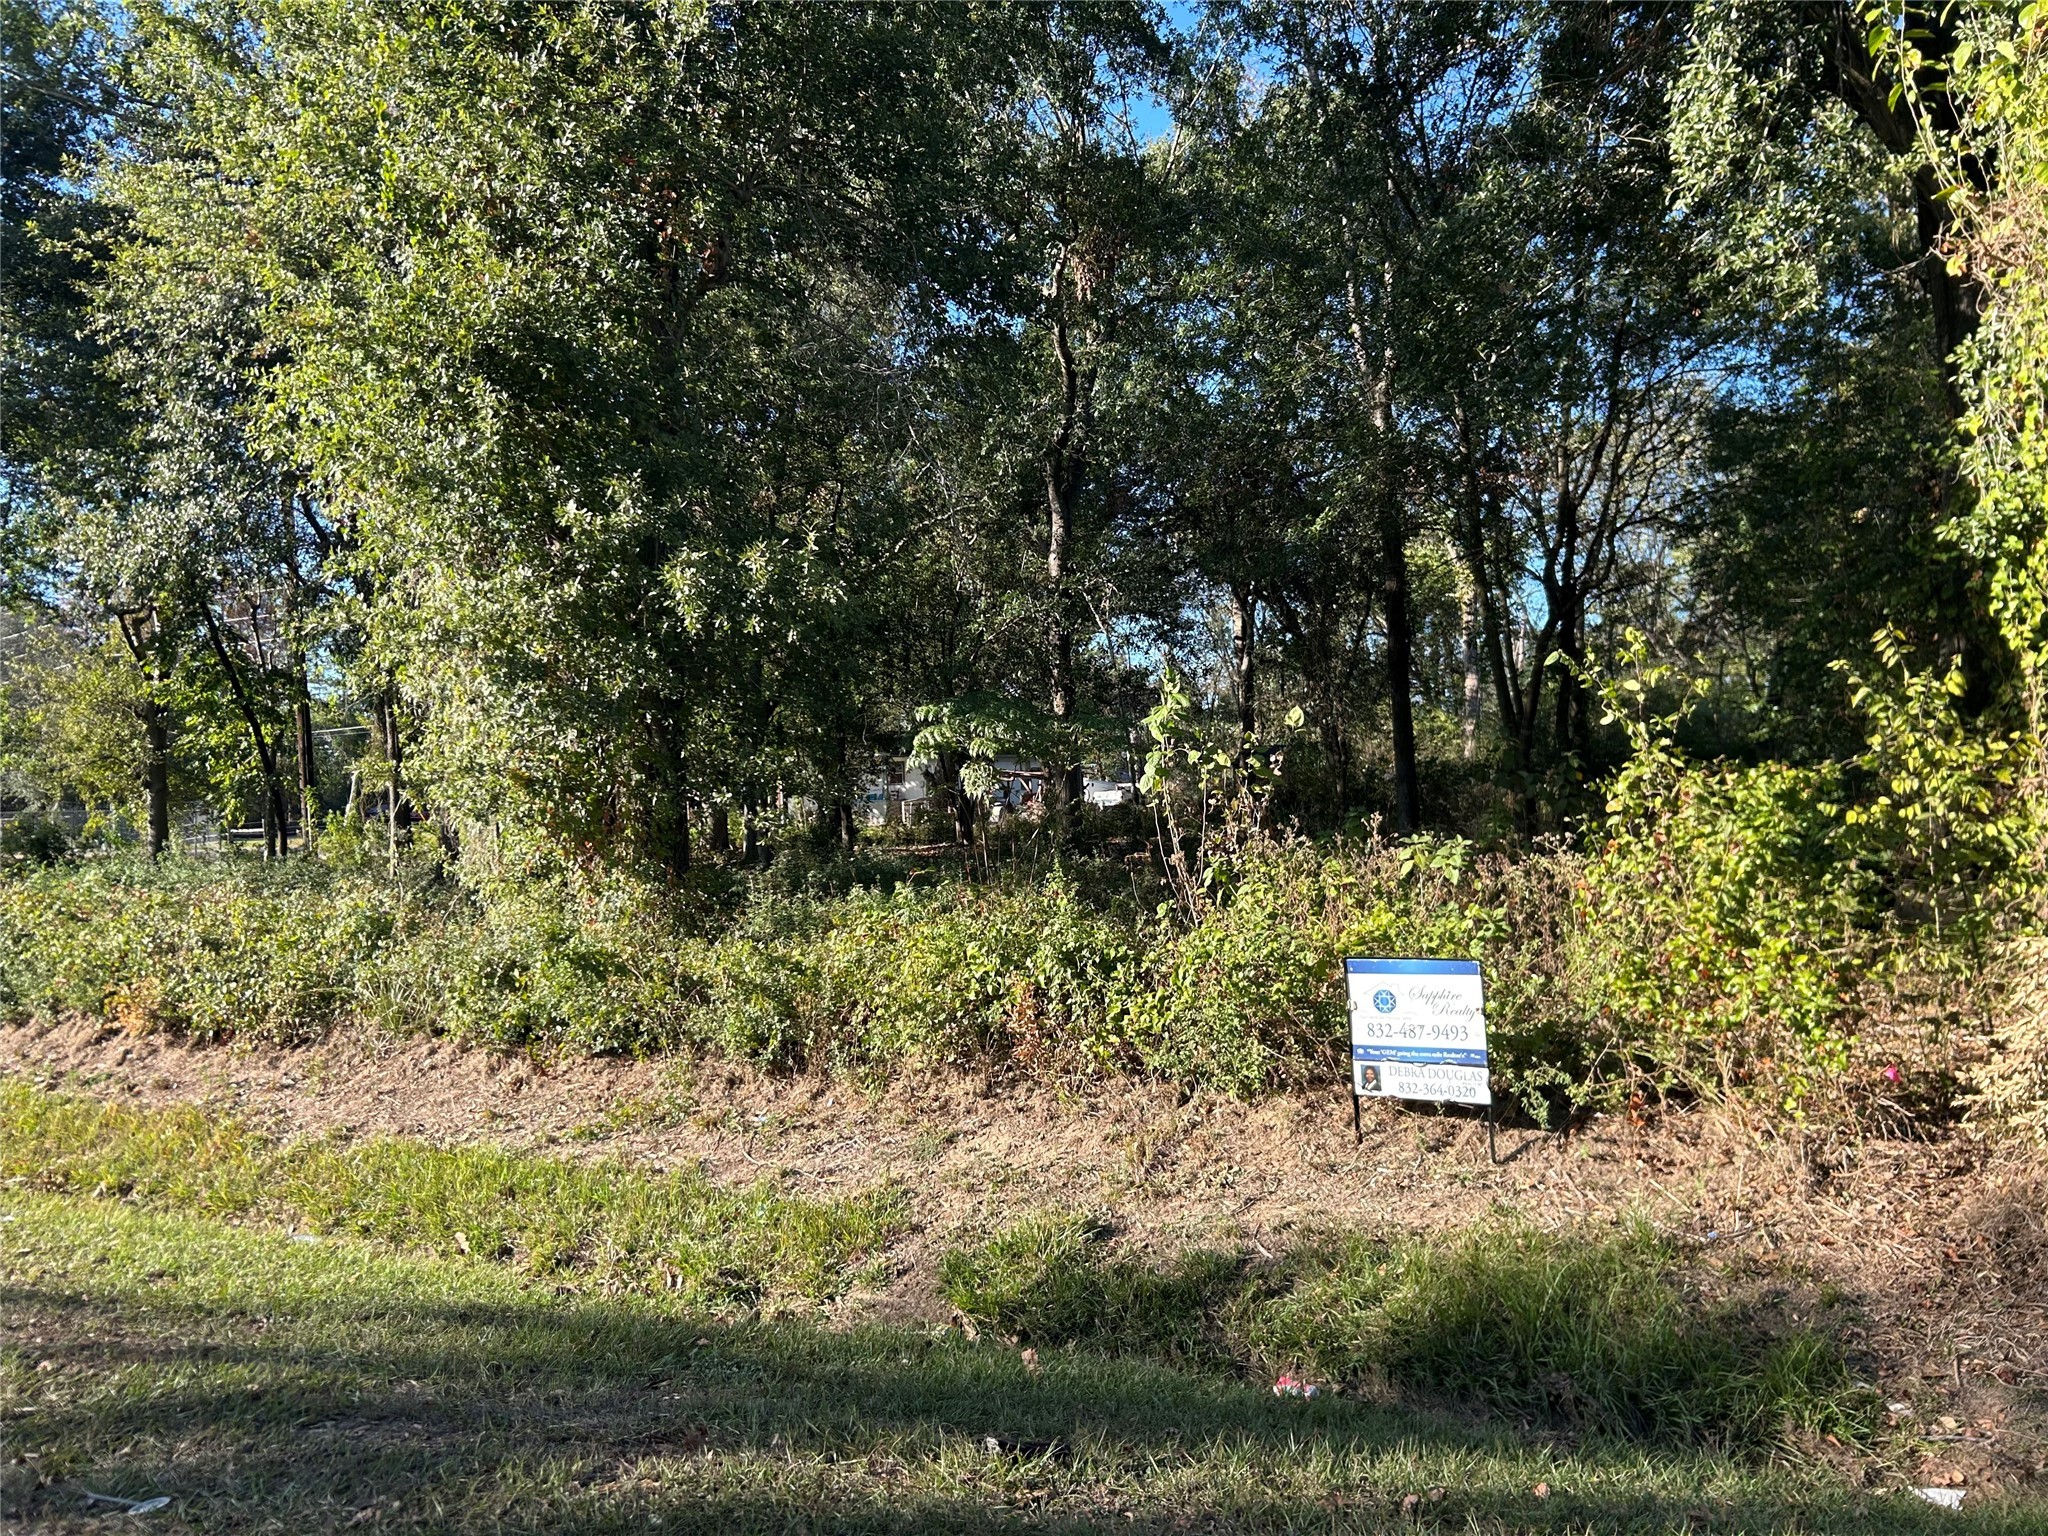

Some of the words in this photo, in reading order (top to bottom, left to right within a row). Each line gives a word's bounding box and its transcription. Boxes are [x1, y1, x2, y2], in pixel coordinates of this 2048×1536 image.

[1409, 985, 1462, 1006] Sapphire
[1432, 1002, 1476, 1022] Realty
[1367, 1022, 1469, 1042] 832-487-9493
[1389, 1066, 1425, 1079] DEBRA
[1428, 1069, 1483, 1082] DOUGLAS
[1398, 1081, 1476, 1098] 832-364-0320
